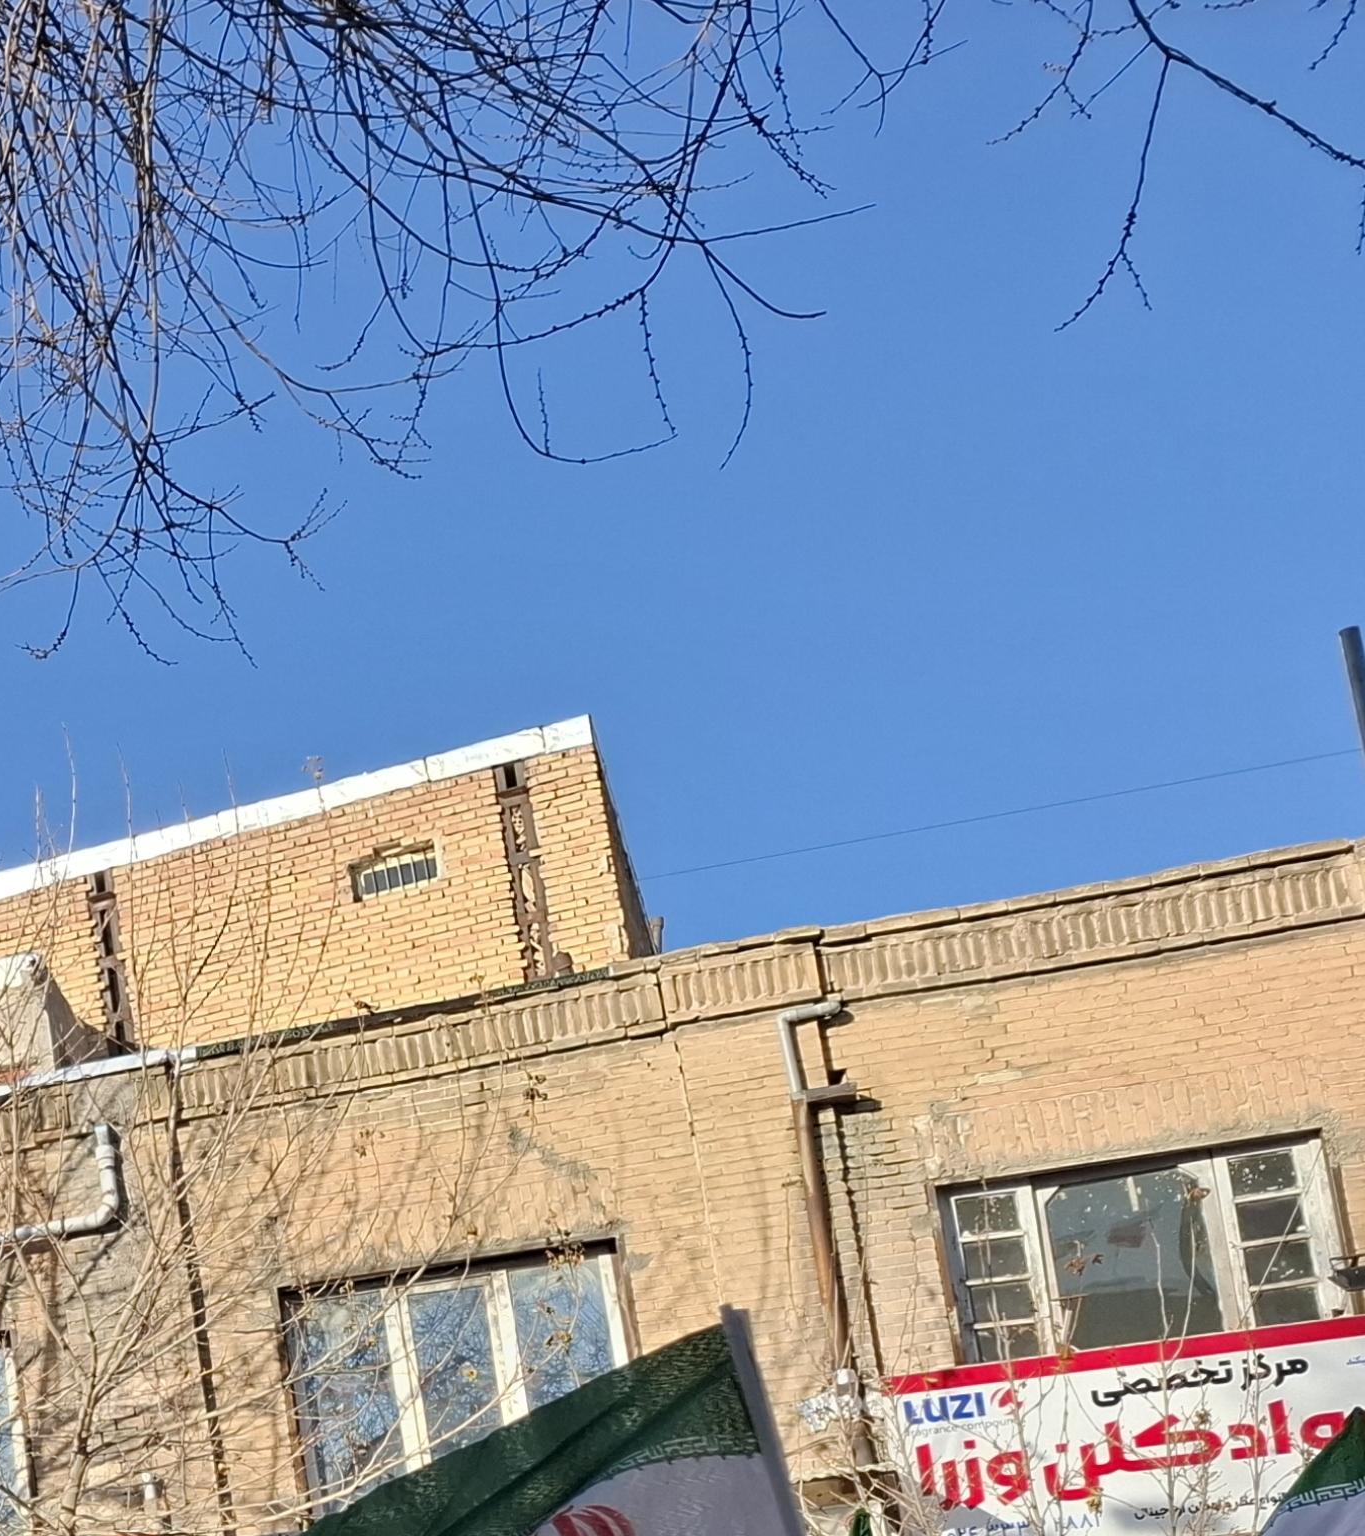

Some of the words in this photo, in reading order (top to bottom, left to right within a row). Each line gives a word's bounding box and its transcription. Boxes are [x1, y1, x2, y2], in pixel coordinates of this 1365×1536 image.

[1090, 1359, 1233, 1408] تخصصی
[1240, 1353, 1309, 1391] مرکز
[903, 1391, 987, 1425] LUZI
[915, 1439, 1030, 1511] وزرا
